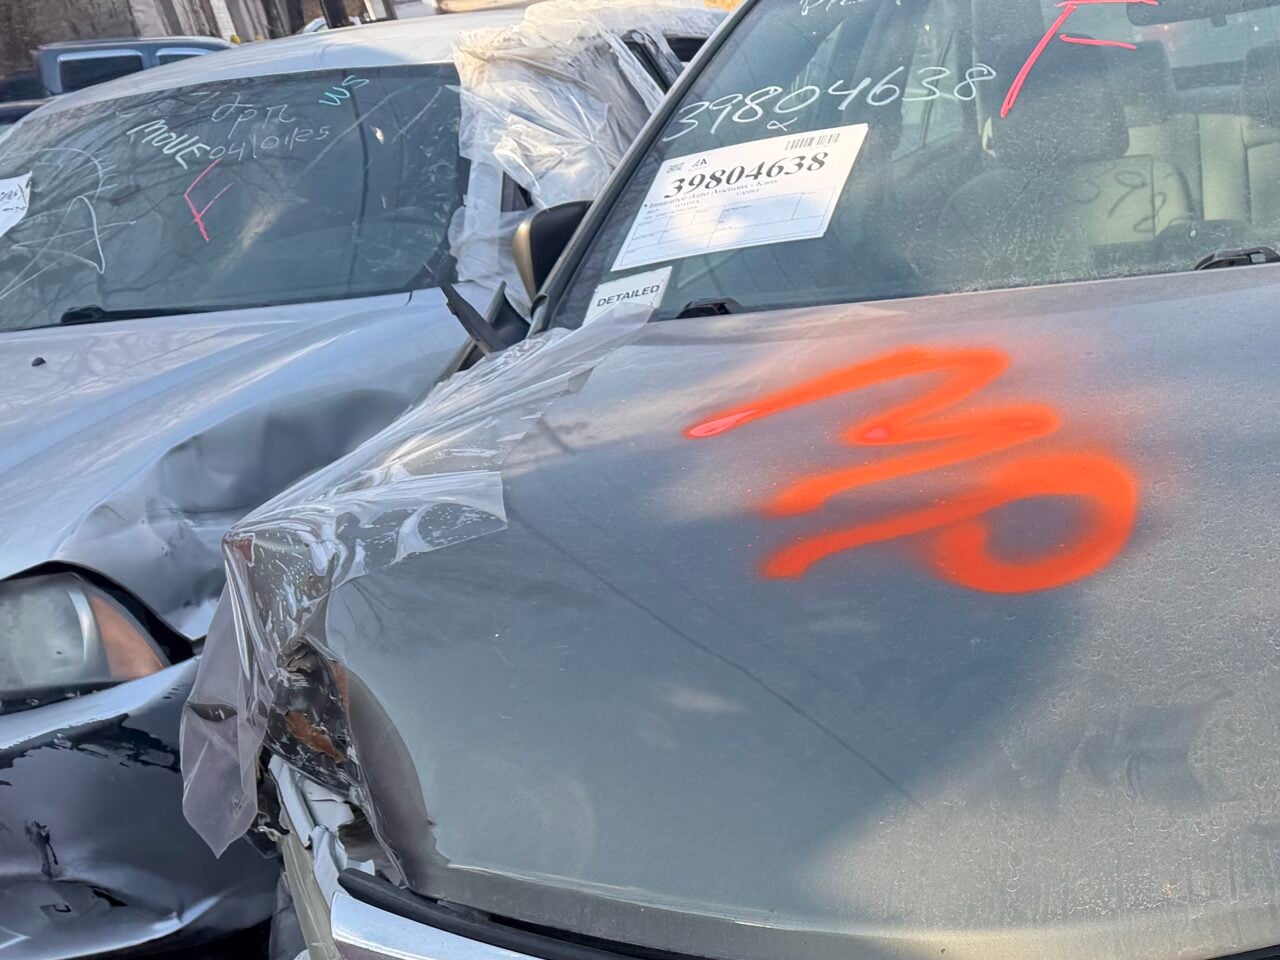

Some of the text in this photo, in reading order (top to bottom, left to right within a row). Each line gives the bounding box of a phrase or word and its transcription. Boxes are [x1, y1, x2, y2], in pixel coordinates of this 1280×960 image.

[662, 63, 997, 143] 39804638
[126, 118, 211, 170] MOVE
[664, 151, 829, 199] 39804638
[597, 284, 660, 307] DETAILED
